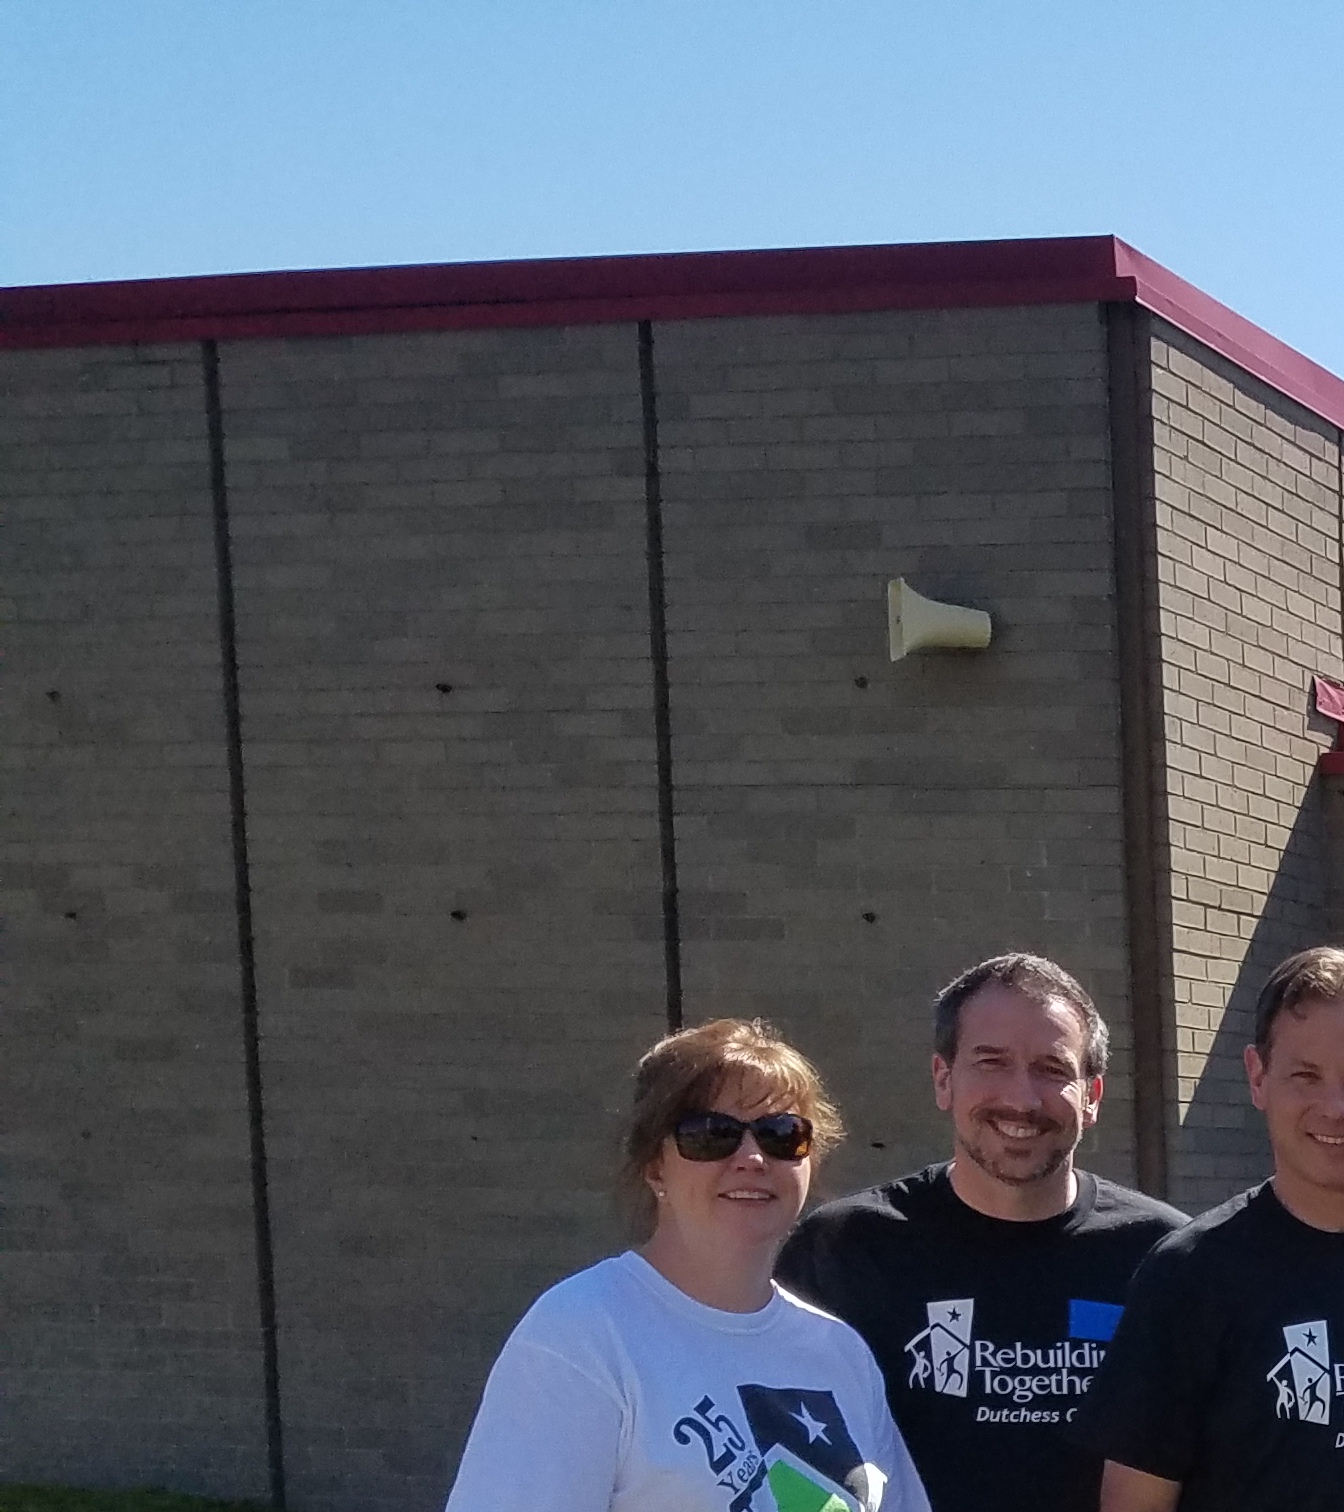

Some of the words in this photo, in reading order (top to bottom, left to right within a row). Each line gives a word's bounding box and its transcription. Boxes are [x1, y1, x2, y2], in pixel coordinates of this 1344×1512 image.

[974, 1340, 1107, 1368] Rebuildi
[975, 1406, 1060, 1424] Dutchess
[673, 1394, 746, 1476] 25
